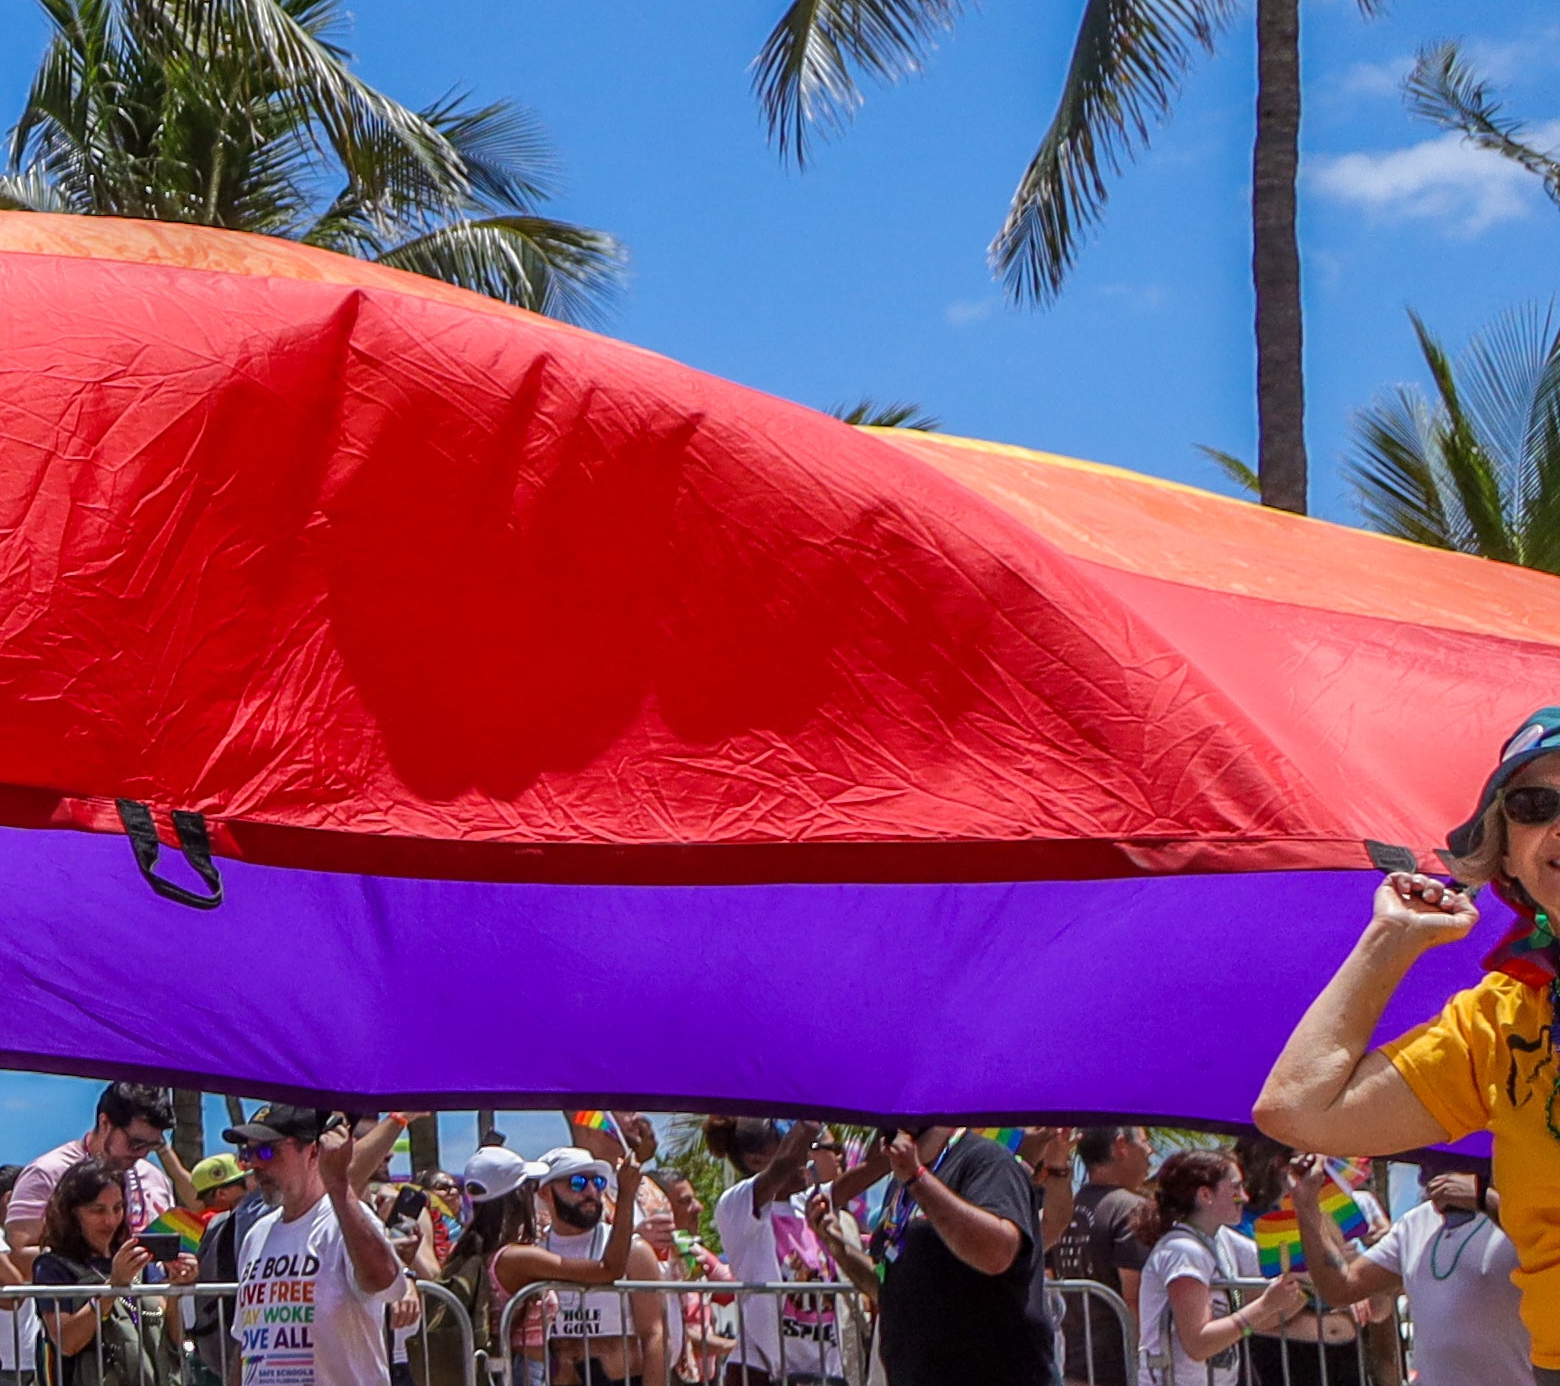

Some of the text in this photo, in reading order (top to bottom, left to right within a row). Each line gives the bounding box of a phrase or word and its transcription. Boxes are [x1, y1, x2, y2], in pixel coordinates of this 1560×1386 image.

[242, 1254, 320, 1282] BE BOLD
[269, 1281, 316, 1303] FREE
[263, 1306, 315, 1324] WOKE
[563, 1308, 601, 1321] HOLE
[563, 1322, 601, 1334] GOAL
[242, 1326, 314, 1351] OVE ALL
